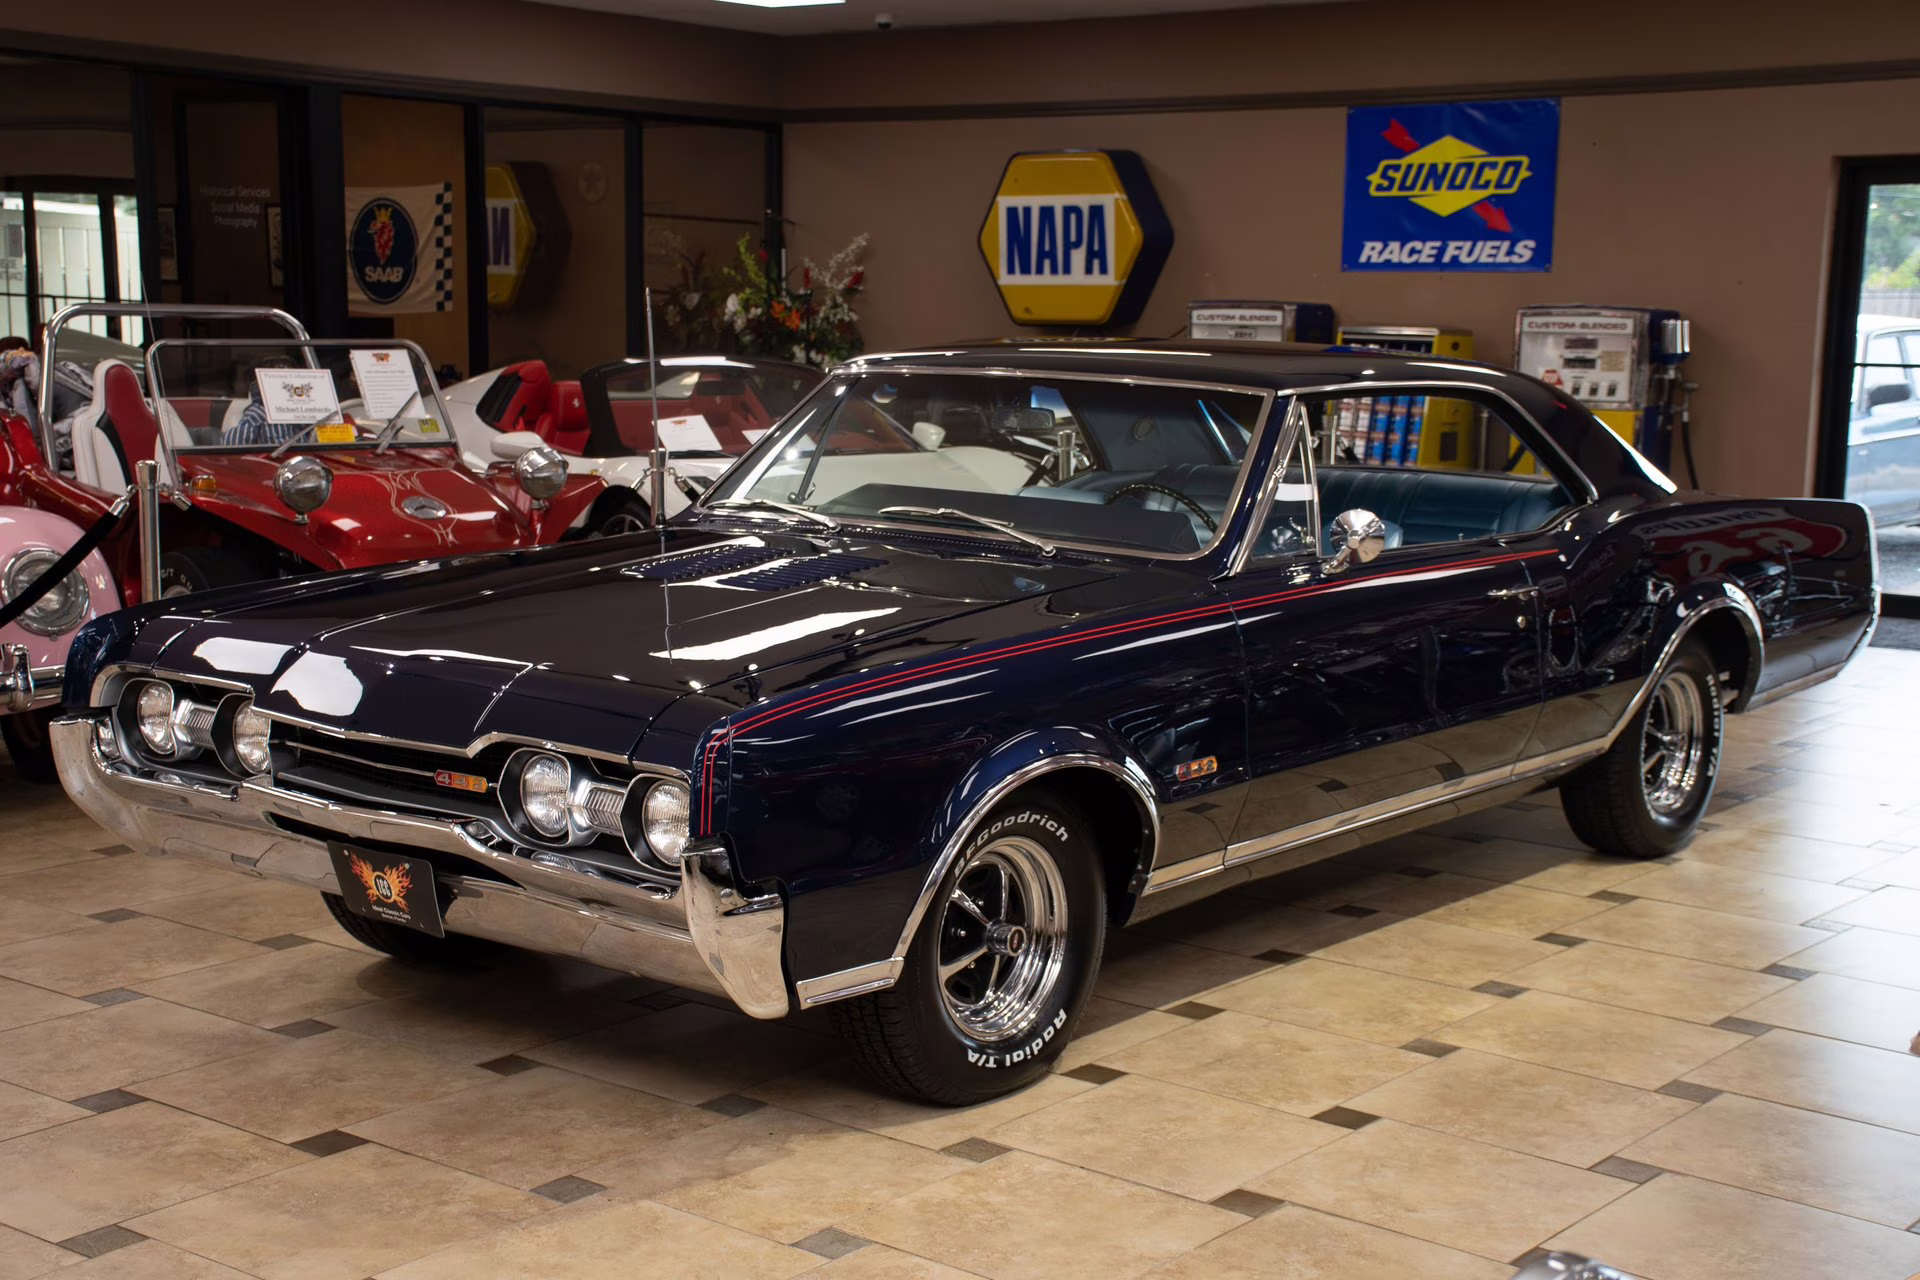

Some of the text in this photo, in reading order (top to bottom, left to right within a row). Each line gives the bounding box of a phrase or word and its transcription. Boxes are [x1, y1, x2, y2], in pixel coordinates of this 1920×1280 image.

[1372, 160, 1525, 192] SUNOCO
[1006, 205, 1108, 275] NAPA
[1358, 240, 1536, 264] RACE FUELS
[364, 265, 404, 283] SAAB
[438, 772, 484, 791] 442
[954, 811, 1069, 879] BFGoodrich
[967, 1008, 1067, 1068] Radial T/A
